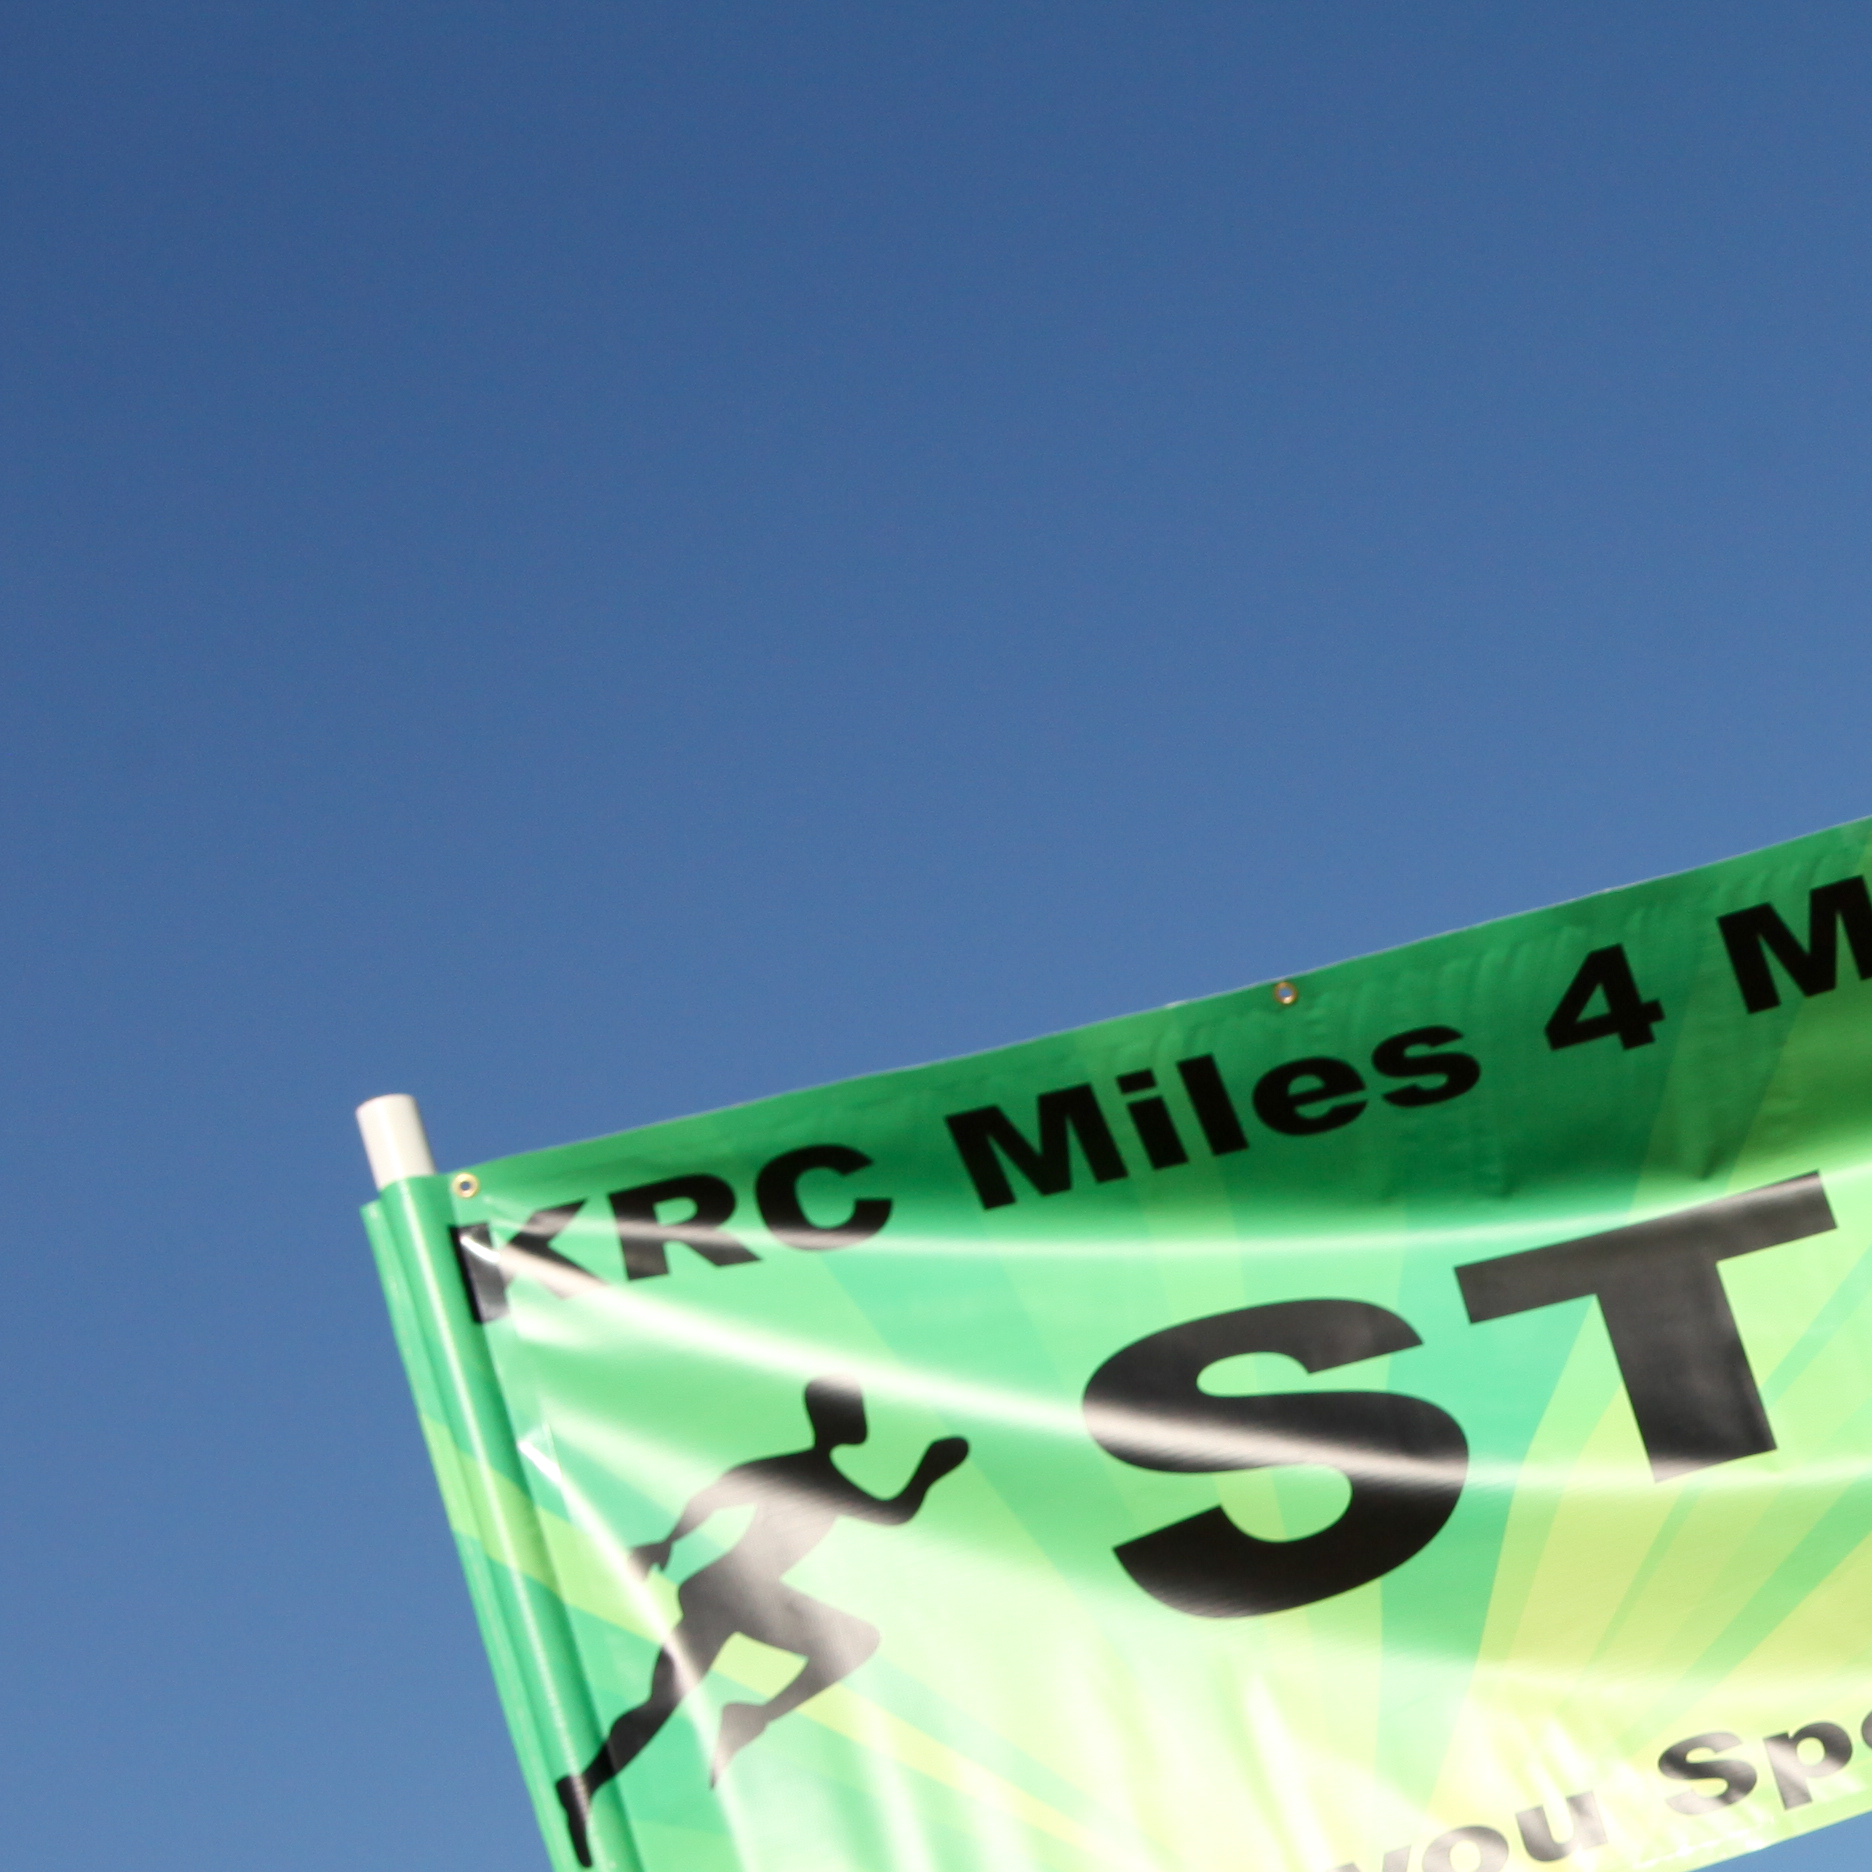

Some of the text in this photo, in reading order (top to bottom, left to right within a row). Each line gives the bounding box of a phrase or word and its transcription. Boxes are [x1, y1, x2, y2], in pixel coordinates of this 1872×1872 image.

[447, 1144, 895, 1325] KRC
[944, 1022, 1482, 1211] Miles
[1543, 942, 1666, 1052] 4
